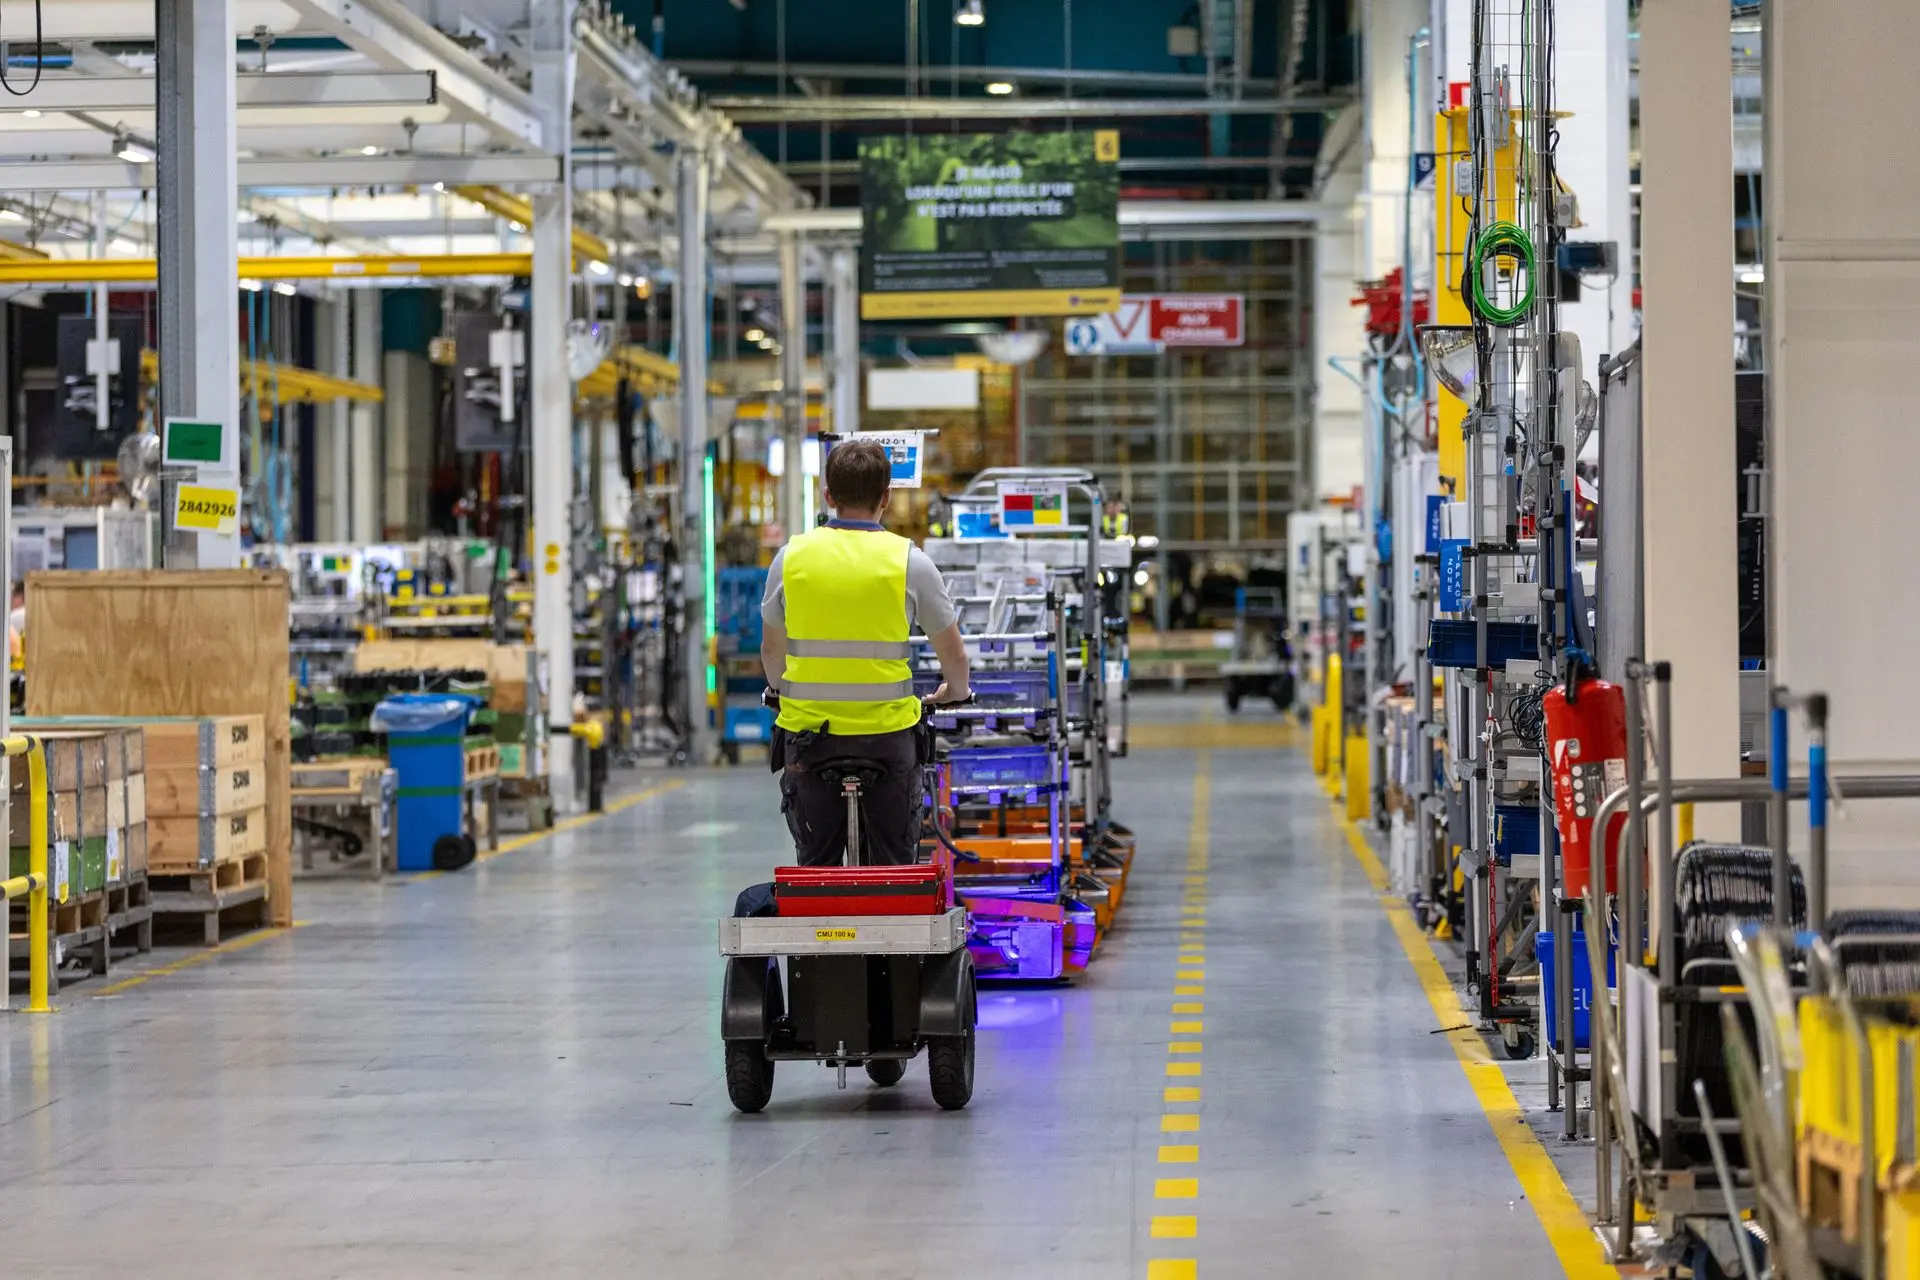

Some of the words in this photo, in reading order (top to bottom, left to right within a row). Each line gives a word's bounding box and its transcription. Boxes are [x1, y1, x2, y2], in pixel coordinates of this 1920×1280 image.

[179, 499, 237, 517] 2842926
[1455, 544, 1463, 607] BIPPAGE
[847, 931, 856, 939] kg
